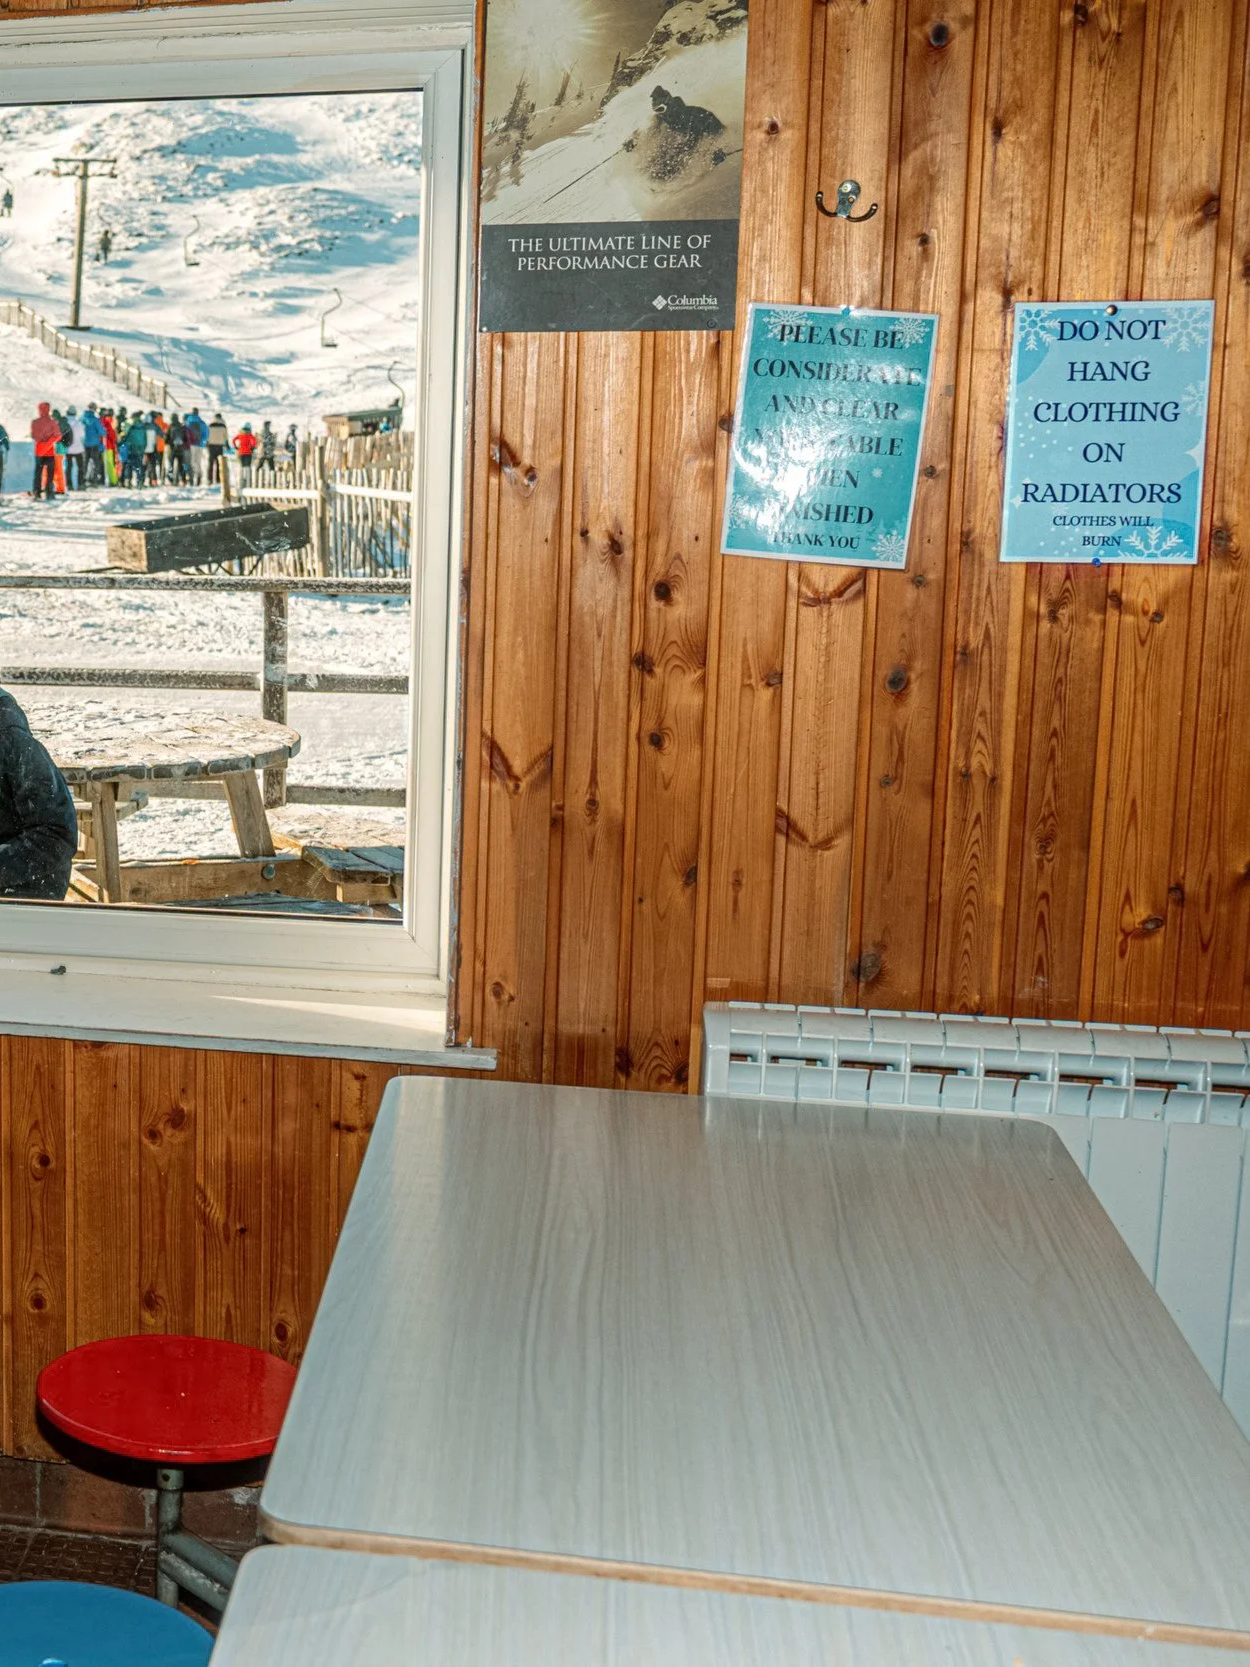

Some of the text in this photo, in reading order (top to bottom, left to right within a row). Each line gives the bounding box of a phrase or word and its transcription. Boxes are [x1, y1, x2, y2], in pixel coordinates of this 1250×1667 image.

[508, 234, 712, 252] THE ULTIMATE LINE OF
[517, 254, 702, 271] PERFORMANCE GEAR
[667, 294, 718, 306] Columbia
[778, 323, 905, 350] PLEASE BE
[1057, 319, 1167, 341] DO NOT
[1066, 360, 1151, 382] HANG
[763, 394, 900, 421] AND CLEAR
[1033, 401, 1181, 423] CLOTHING
[1082, 442, 1125, 463] ON
[1022, 482, 1182, 504] RADIATORS
[1053, 515, 1155, 527] CLOTHES WILL
[828, 534, 861, 550] YOU
[1081, 535, 1122, 547] BURN
